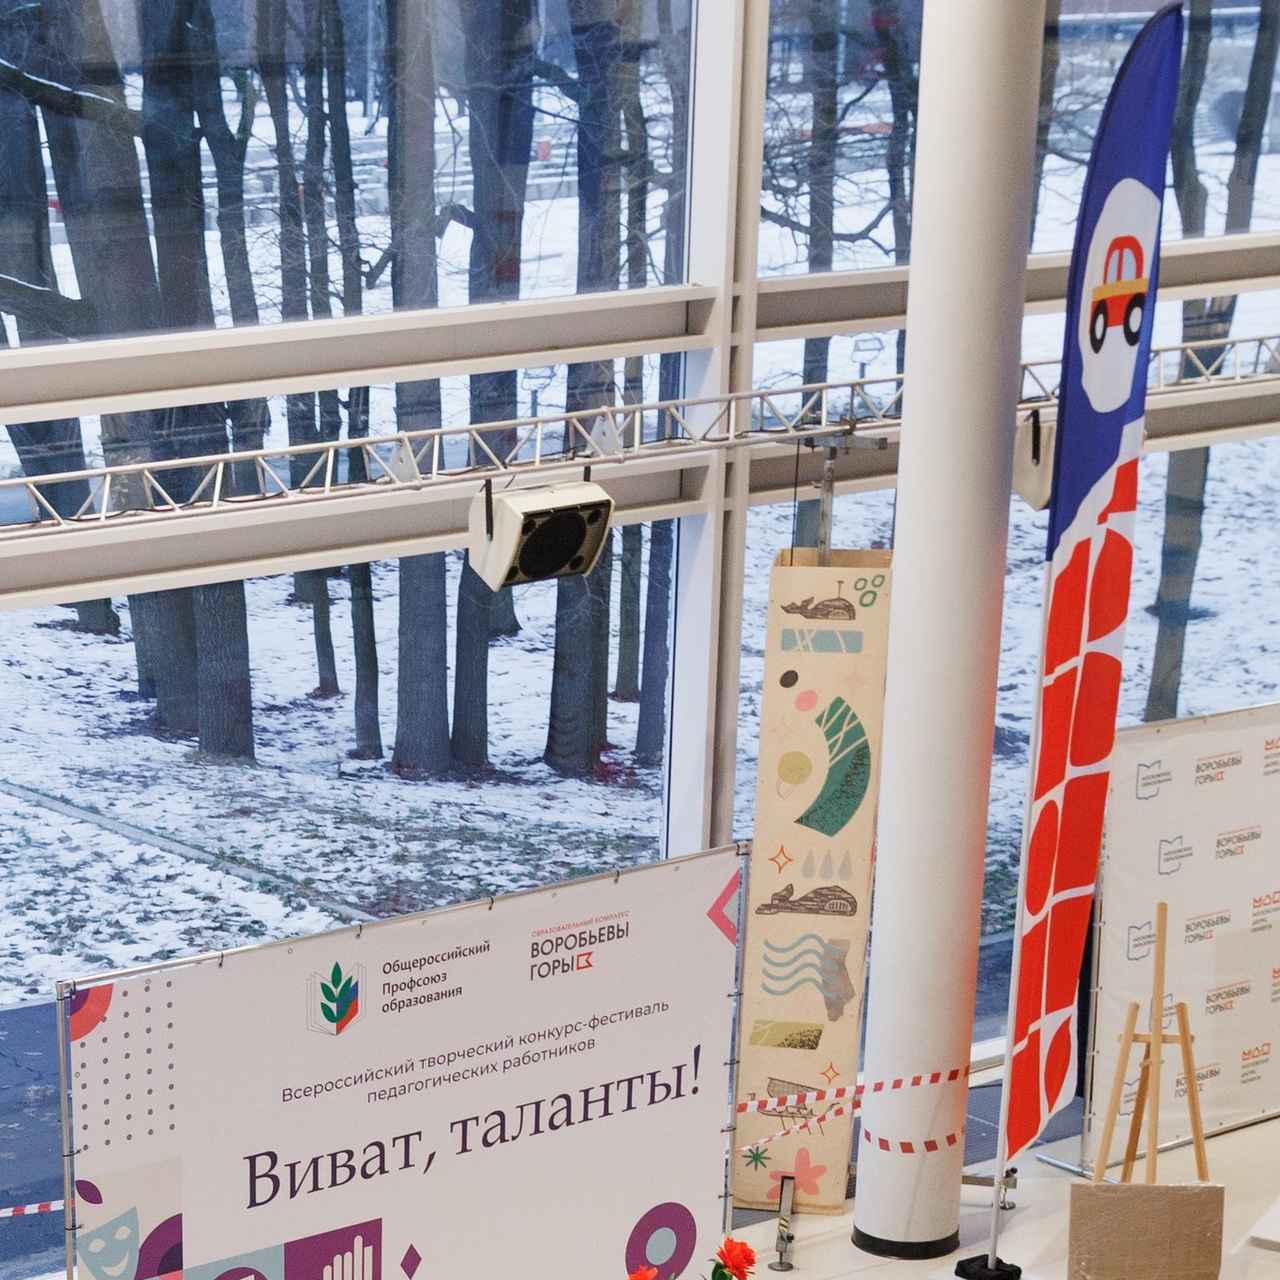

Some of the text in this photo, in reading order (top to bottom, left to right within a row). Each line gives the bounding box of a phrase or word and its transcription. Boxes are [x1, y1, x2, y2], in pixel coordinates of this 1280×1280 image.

[530, 921, 629, 959] ВОРОБЬЕВЫ
[531, 910, 630, 938] ОБРАЗОВАТЕЛЬНЫЙ КОМПЛЕКС
[382, 940, 491, 975] Общероссийский
[530, 956, 574, 981] ГОРЫ
[381, 985, 463, 1013] образования
[382, 972, 447, 995] Профсоюз
[282, 1001, 669, 1102] Всероссийский творческий конкурс-фестиваль
[367, 1037, 595, 1103] педагогических работников
[243, 1044, 701, 1210] Виват, таланты!
